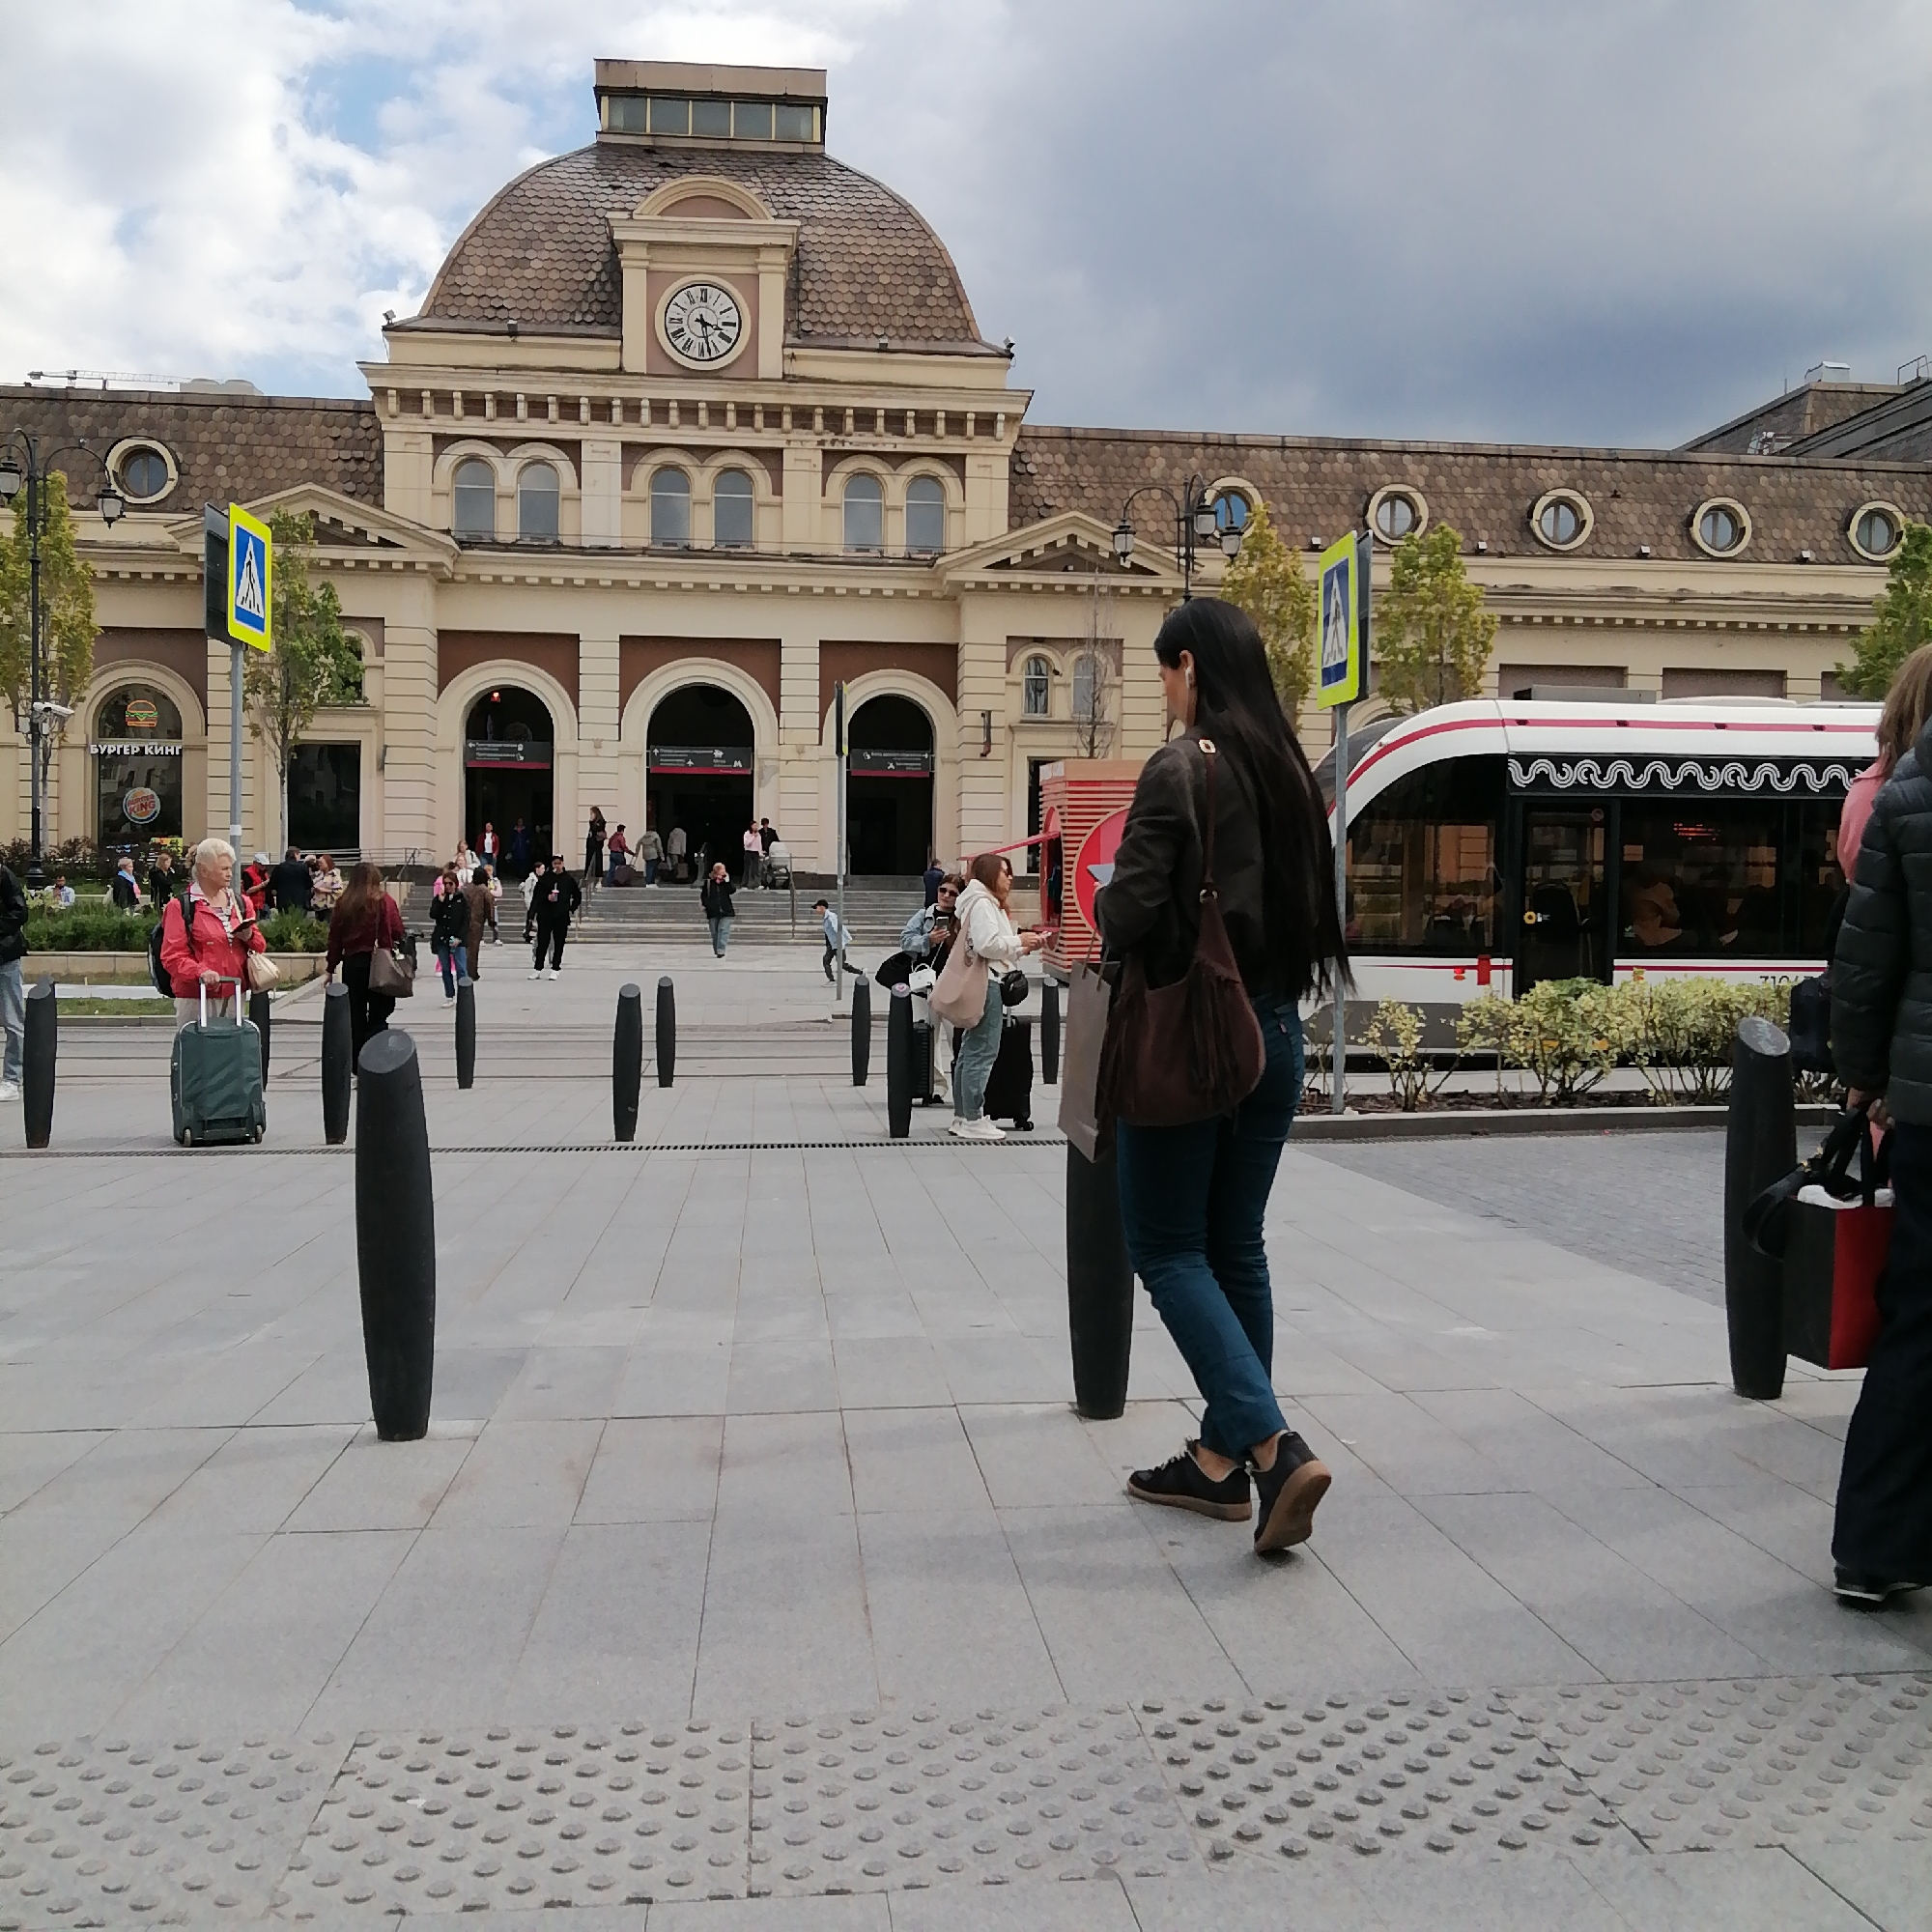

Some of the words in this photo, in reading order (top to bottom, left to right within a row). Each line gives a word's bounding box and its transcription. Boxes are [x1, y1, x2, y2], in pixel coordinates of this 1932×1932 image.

[90, 744, 141, 755] БУРГЕР
[144, 744, 183, 755] КИНГ
[128, 801, 156, 814] KING
